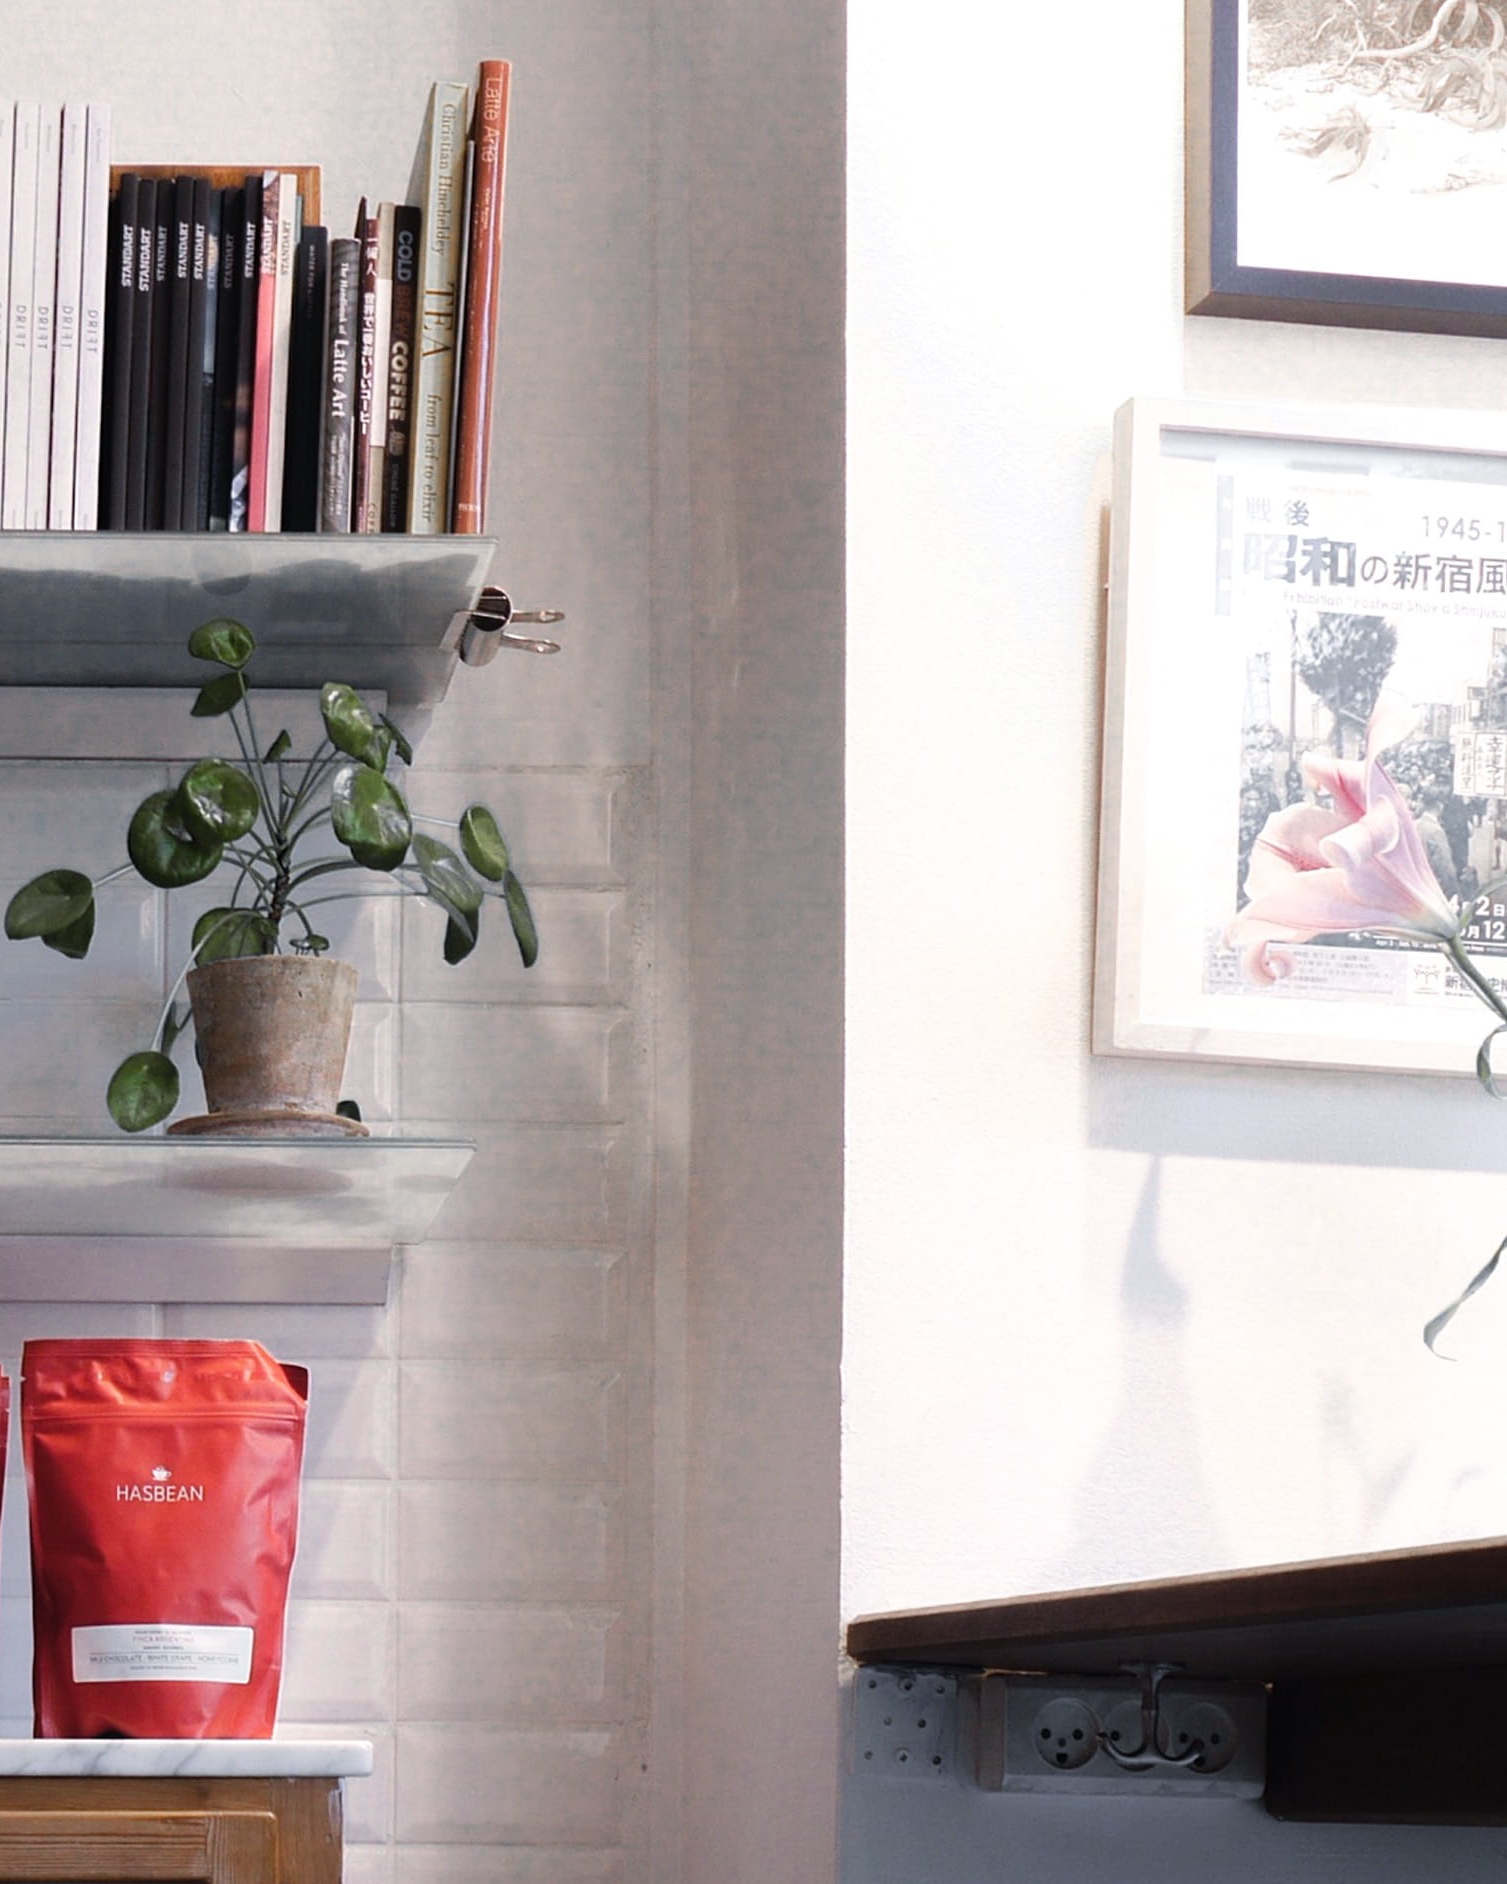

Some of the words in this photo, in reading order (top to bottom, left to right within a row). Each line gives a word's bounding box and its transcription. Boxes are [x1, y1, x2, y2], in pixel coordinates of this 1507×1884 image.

[483, 76, 504, 120] Latte
[439, 103, 456, 171] Christian
[481, 124, 501, 163] Arte
[121, 224, 134, 288] STANDART
[138, 227, 152, 292] STANDART
[156, 225, 167, 282] STANDART
[178, 221, 190, 279] STANDART
[193, 223, 206, 280] STANDART
[224, 234, 234, 289] STANDART
[244, 221, 256, 279] STANDART
[260, 216, 273, 275] STANDART
[281, 220, 292, 277] STANDART
[398, 230, 413, 282] COLD
[423, 282, 454, 357] TEA
[332, 340, 350, 384] Latte
[389, 341, 409, 421] COFFEE
[331, 389, 348, 417] Art
[427, 394, 442, 429] from
[423, 463, 437, 478] to
[425, 433, 440, 462] leaf
[422, 483, 437, 523] elixir
[116, 1484, 204, 1502] HASBEAN
